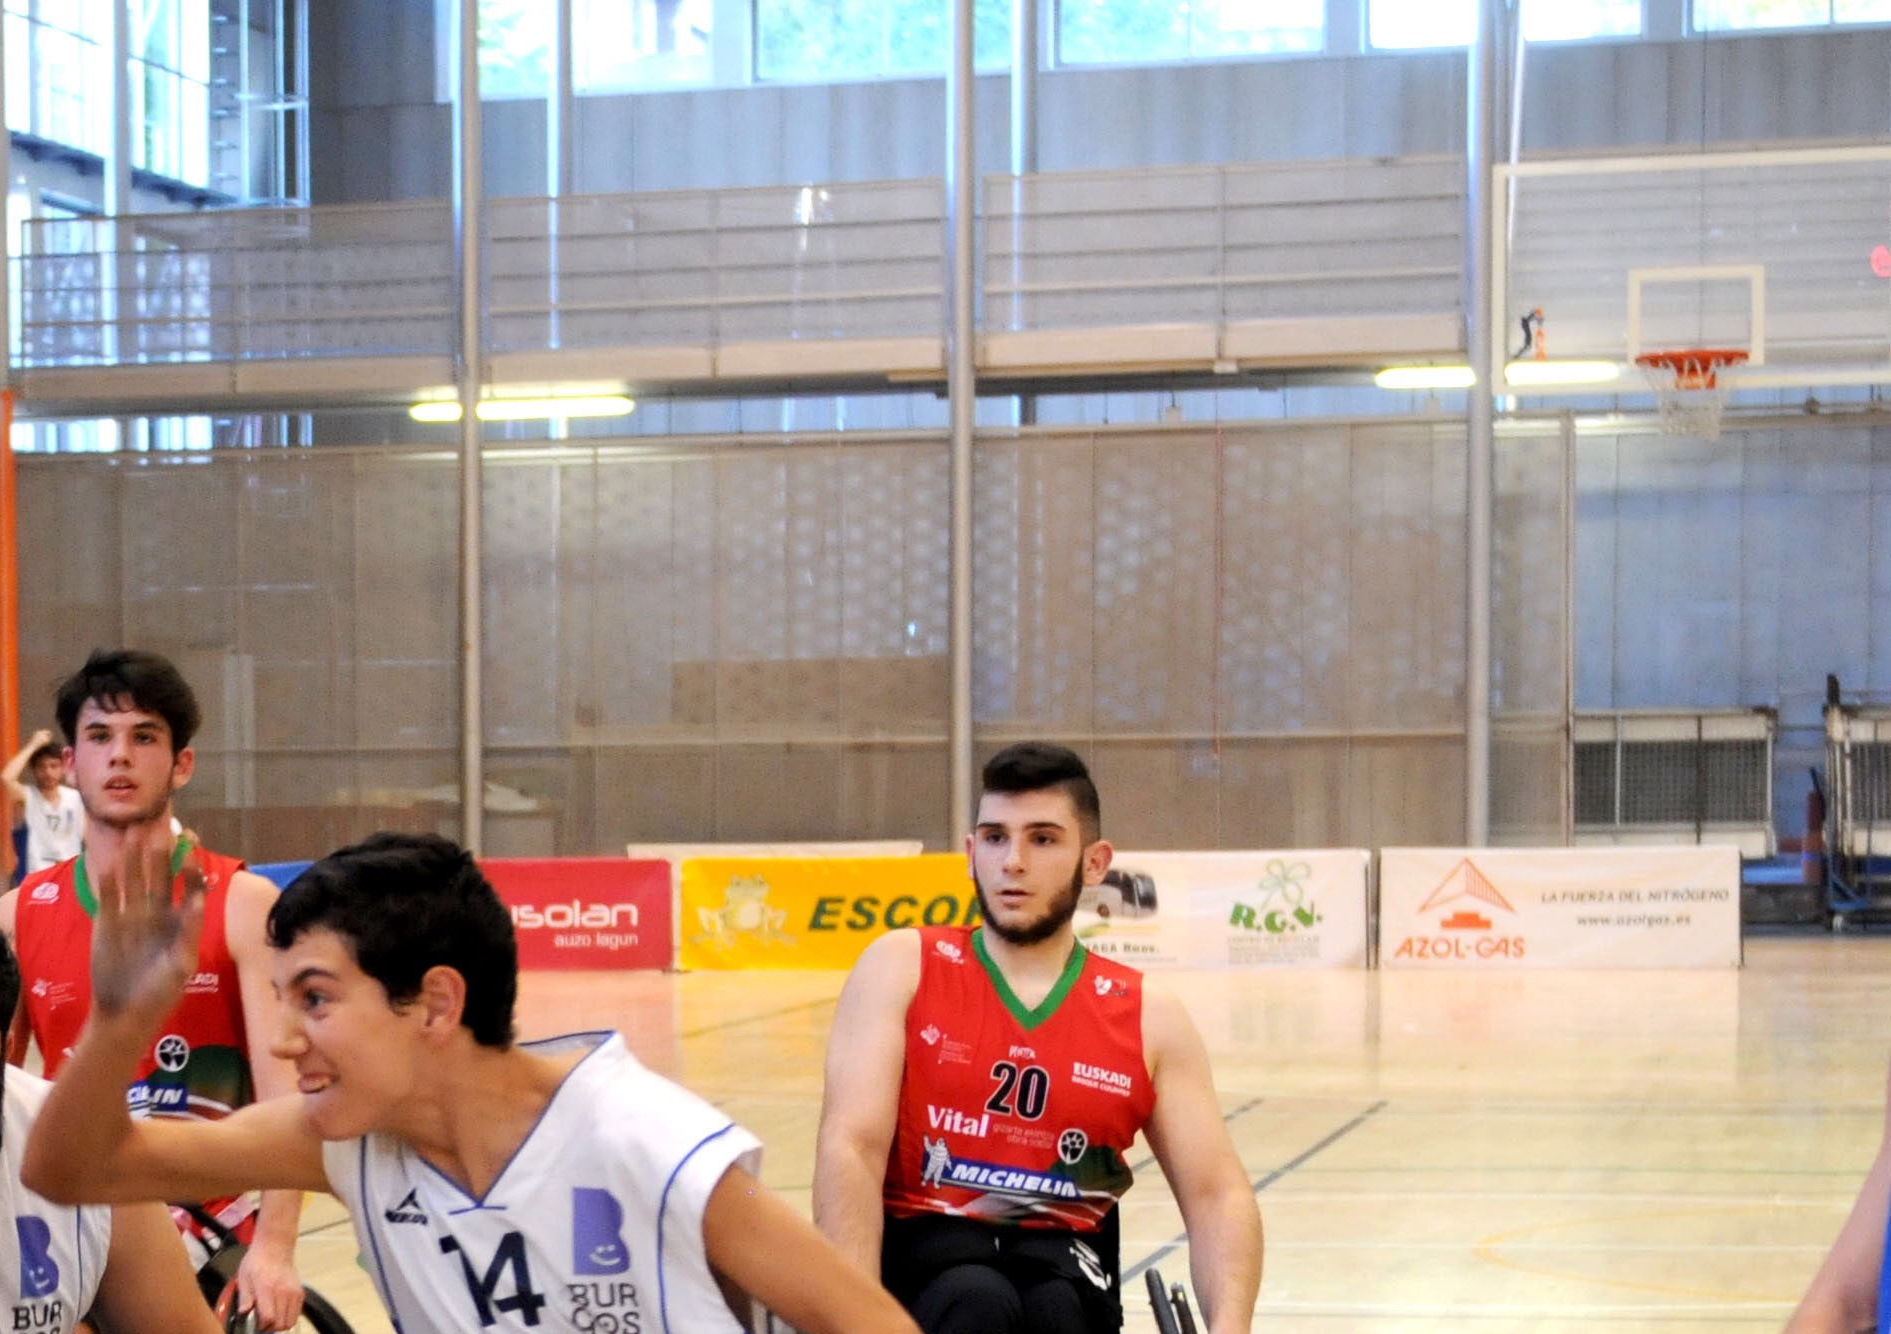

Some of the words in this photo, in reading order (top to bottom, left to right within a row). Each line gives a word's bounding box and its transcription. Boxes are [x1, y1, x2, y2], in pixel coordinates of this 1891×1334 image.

[1561, 891, 1614, 903] FUERZA
[1620, 890, 1643, 902] DEL
[554, 934, 592, 947] auzo
[595, 932, 638, 951] lagun
[1394, 937, 1526, 959] AZOL-GAS
[1072, 1061, 1132, 1089] EUSKADI
[985, 1060, 1050, 1121] 20
[927, 1104, 990, 1138] Vital
[951, 1163, 1077, 1197] MICHELIN
[439, 1231, 547, 1327] 14
[566, 1282, 640, 1309] BUR
[12, 1300, 61, 1330] BUR
